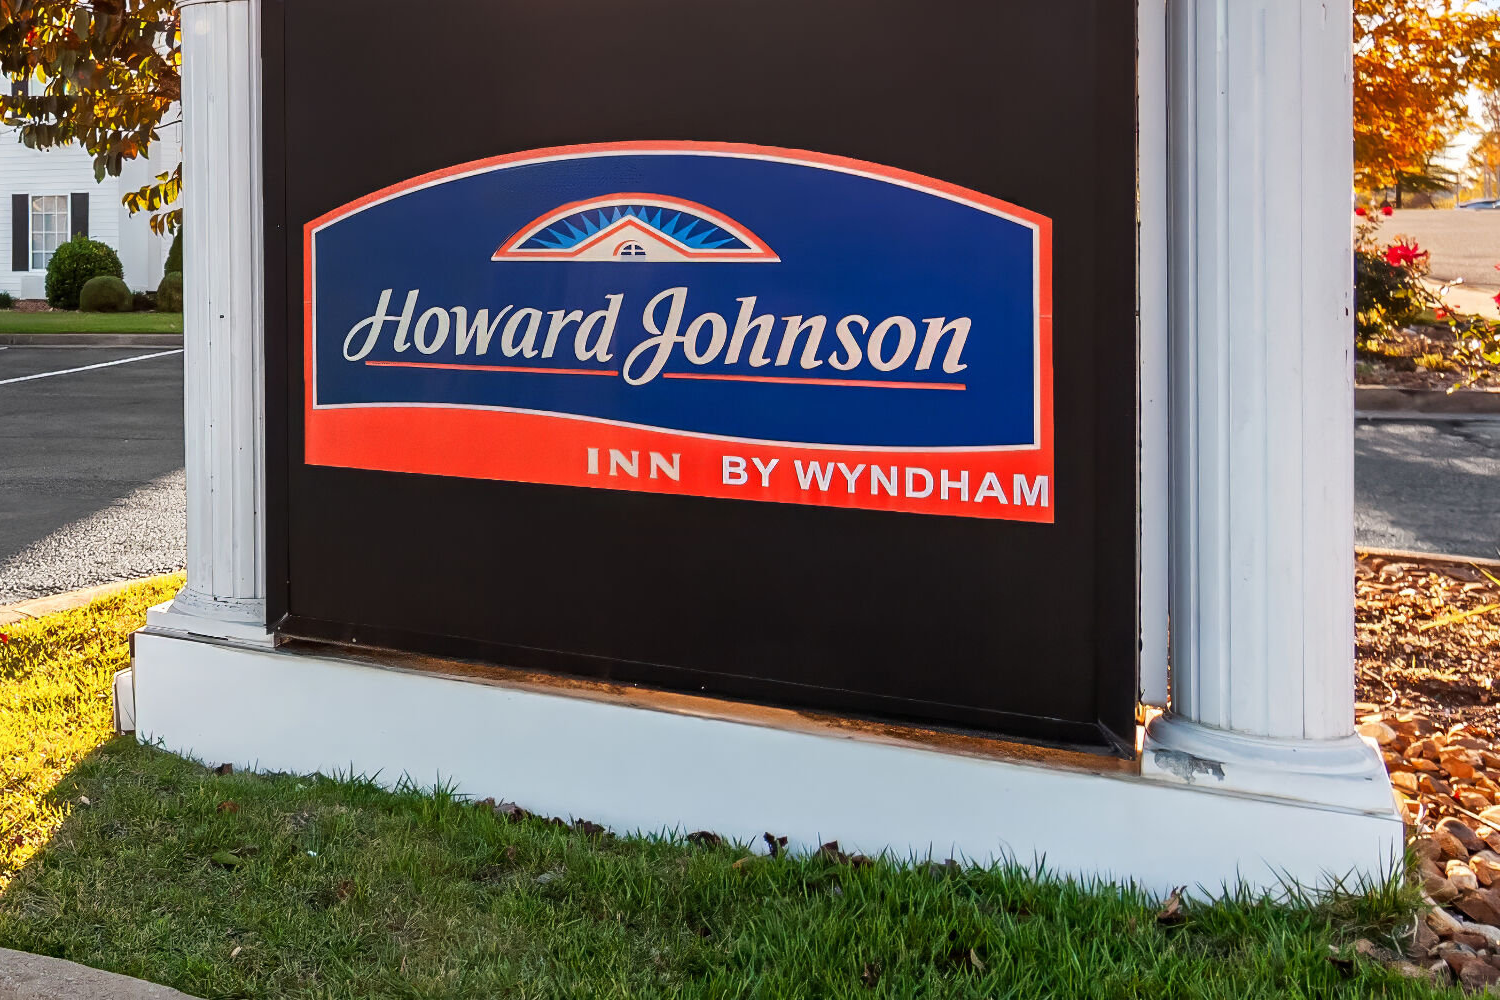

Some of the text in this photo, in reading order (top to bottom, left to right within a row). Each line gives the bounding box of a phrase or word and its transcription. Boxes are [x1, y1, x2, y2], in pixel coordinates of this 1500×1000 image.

[342, 286, 970, 386] Howard Johnson
[587, 447, 1049, 507] INN BY WYNDHAM
